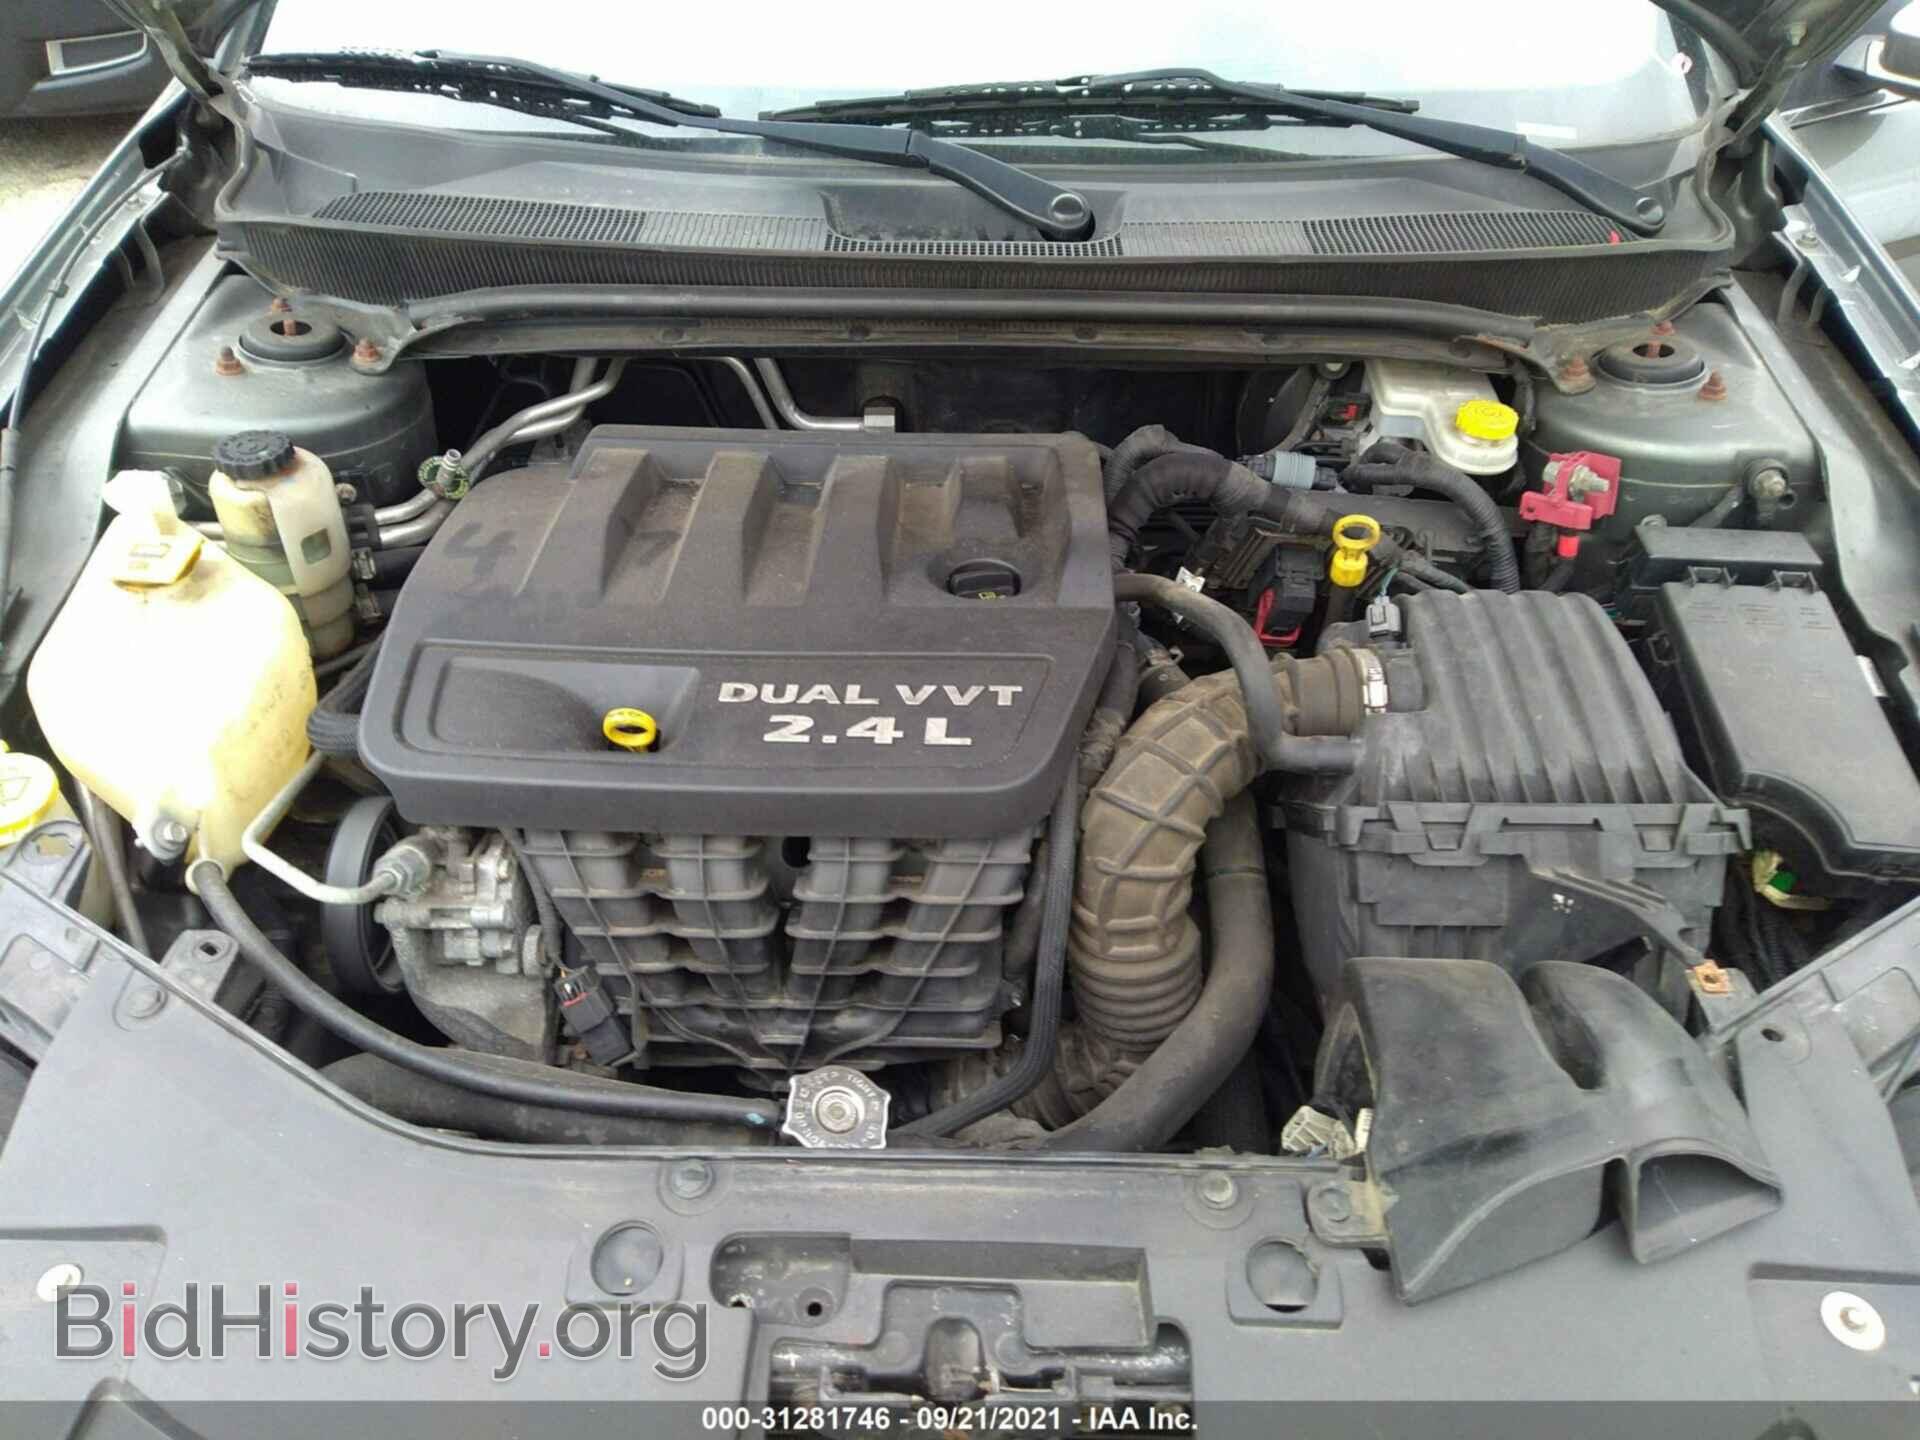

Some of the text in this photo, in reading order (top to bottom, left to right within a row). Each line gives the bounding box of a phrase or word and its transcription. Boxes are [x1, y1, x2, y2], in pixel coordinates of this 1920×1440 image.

[718, 682, 1023, 706] DUAL VVT
[763, 715, 972, 745] 2.4 L
